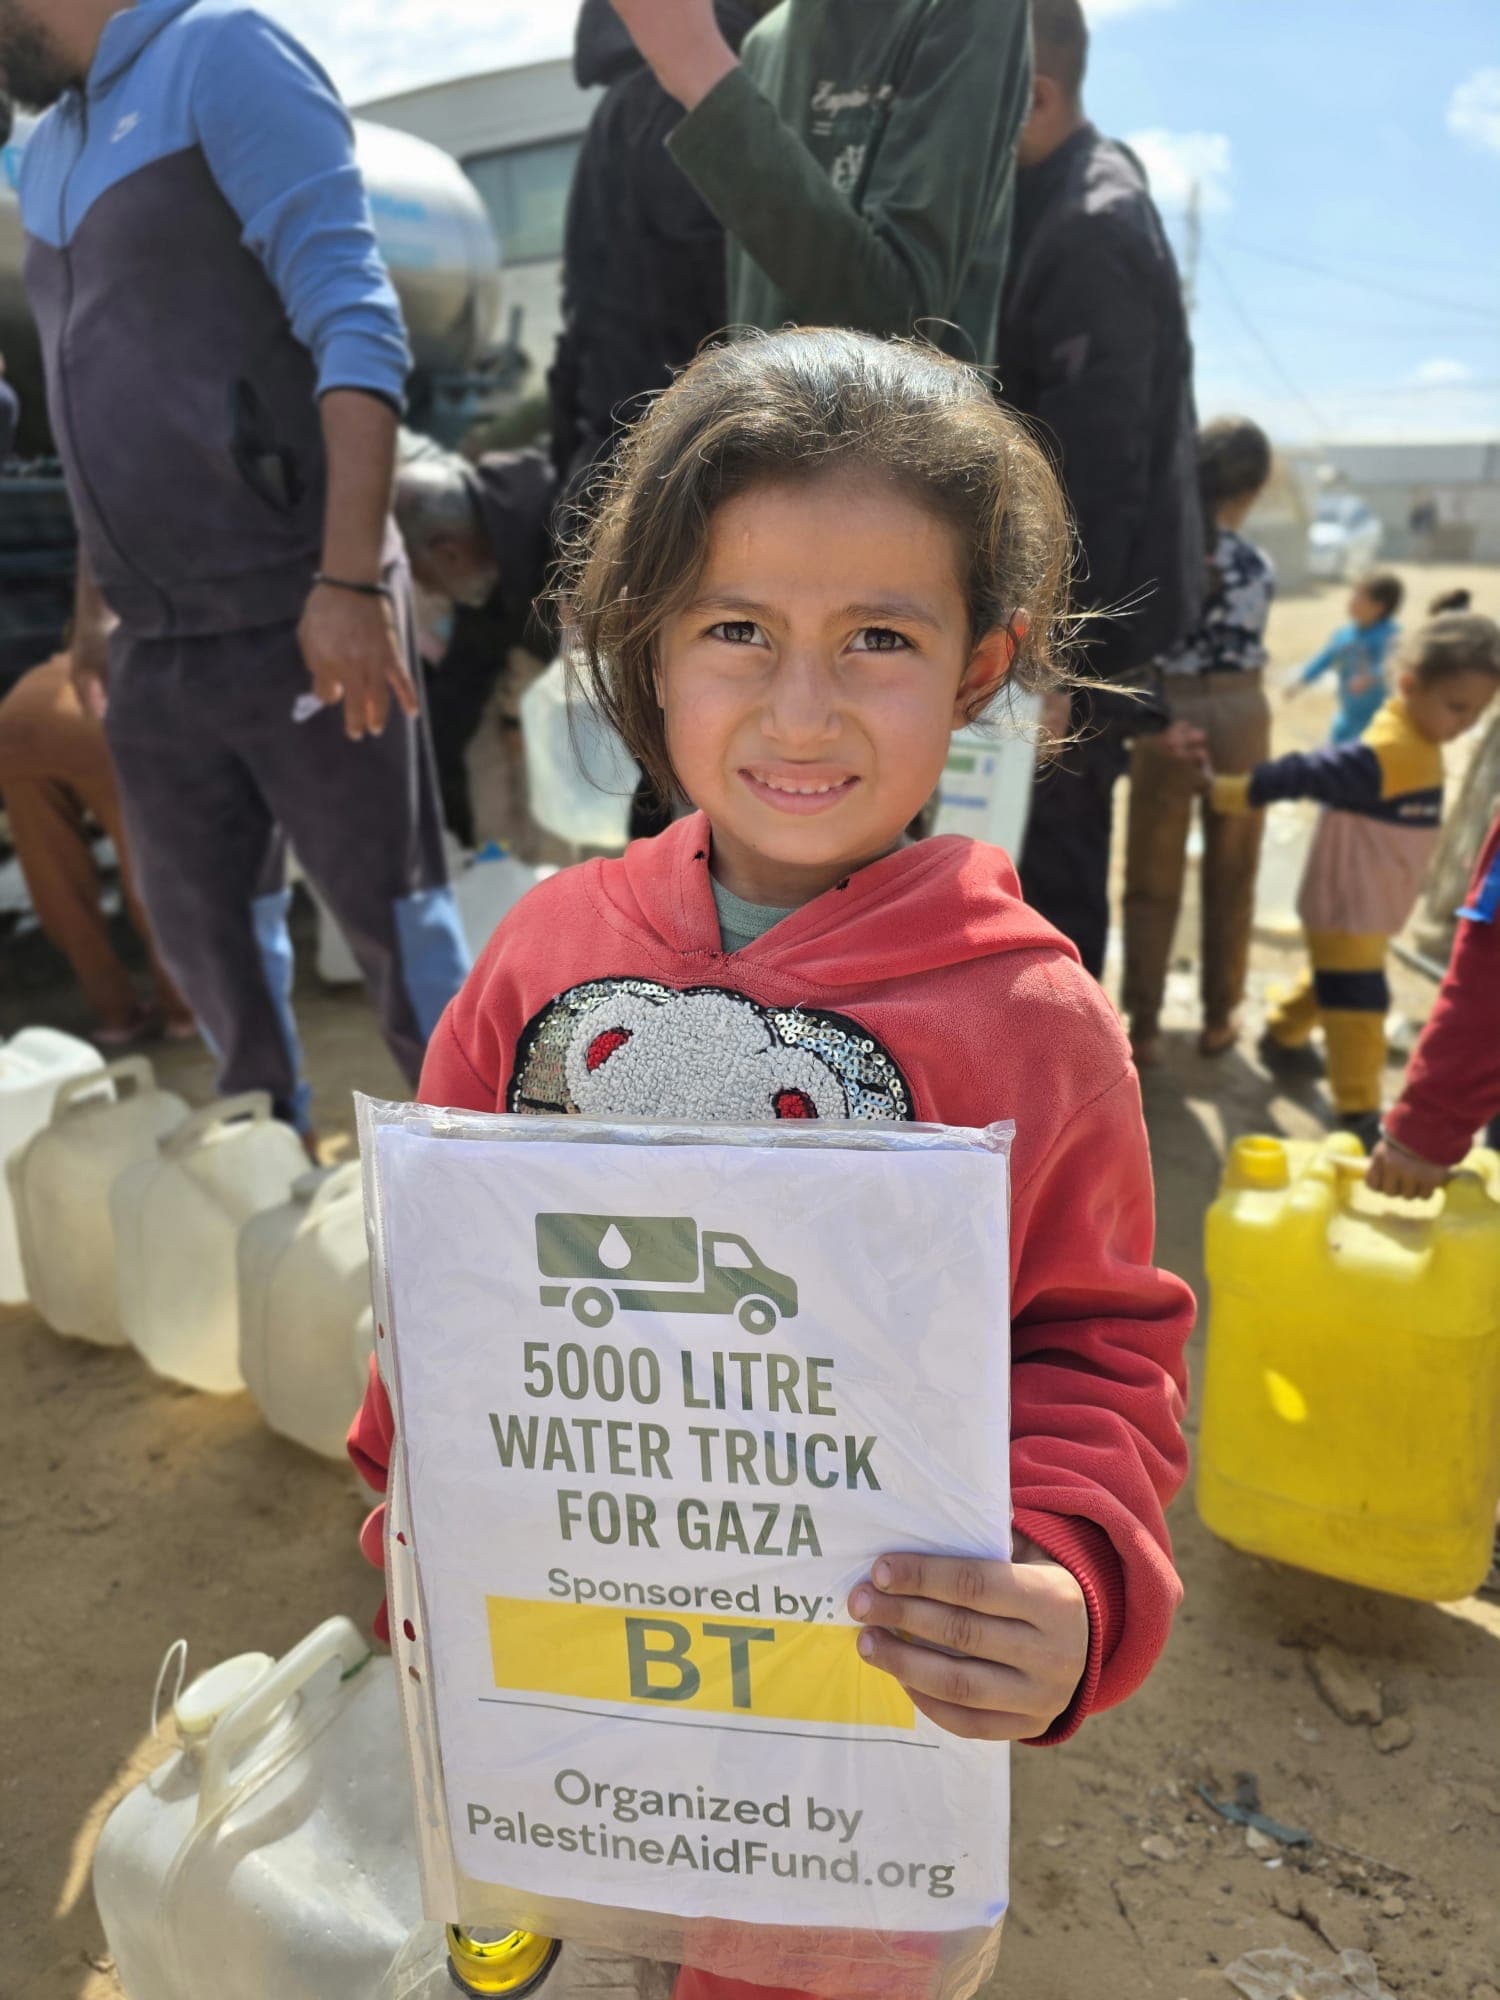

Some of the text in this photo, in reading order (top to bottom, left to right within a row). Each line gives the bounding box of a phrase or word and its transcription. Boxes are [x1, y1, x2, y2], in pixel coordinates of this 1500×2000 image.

[523, 1341, 837, 1416] 5000 LITRE
[488, 1413, 882, 1491] WATER TRUCK
[557, 1489, 823, 1557] FOR GAZA
[548, 1568, 835, 1622] Sponsored by:
[625, 1617, 775, 1709] BT
[554, 1769, 863, 1843] Organized by
[466, 1803, 956, 1897] PalestineAidFund.org
